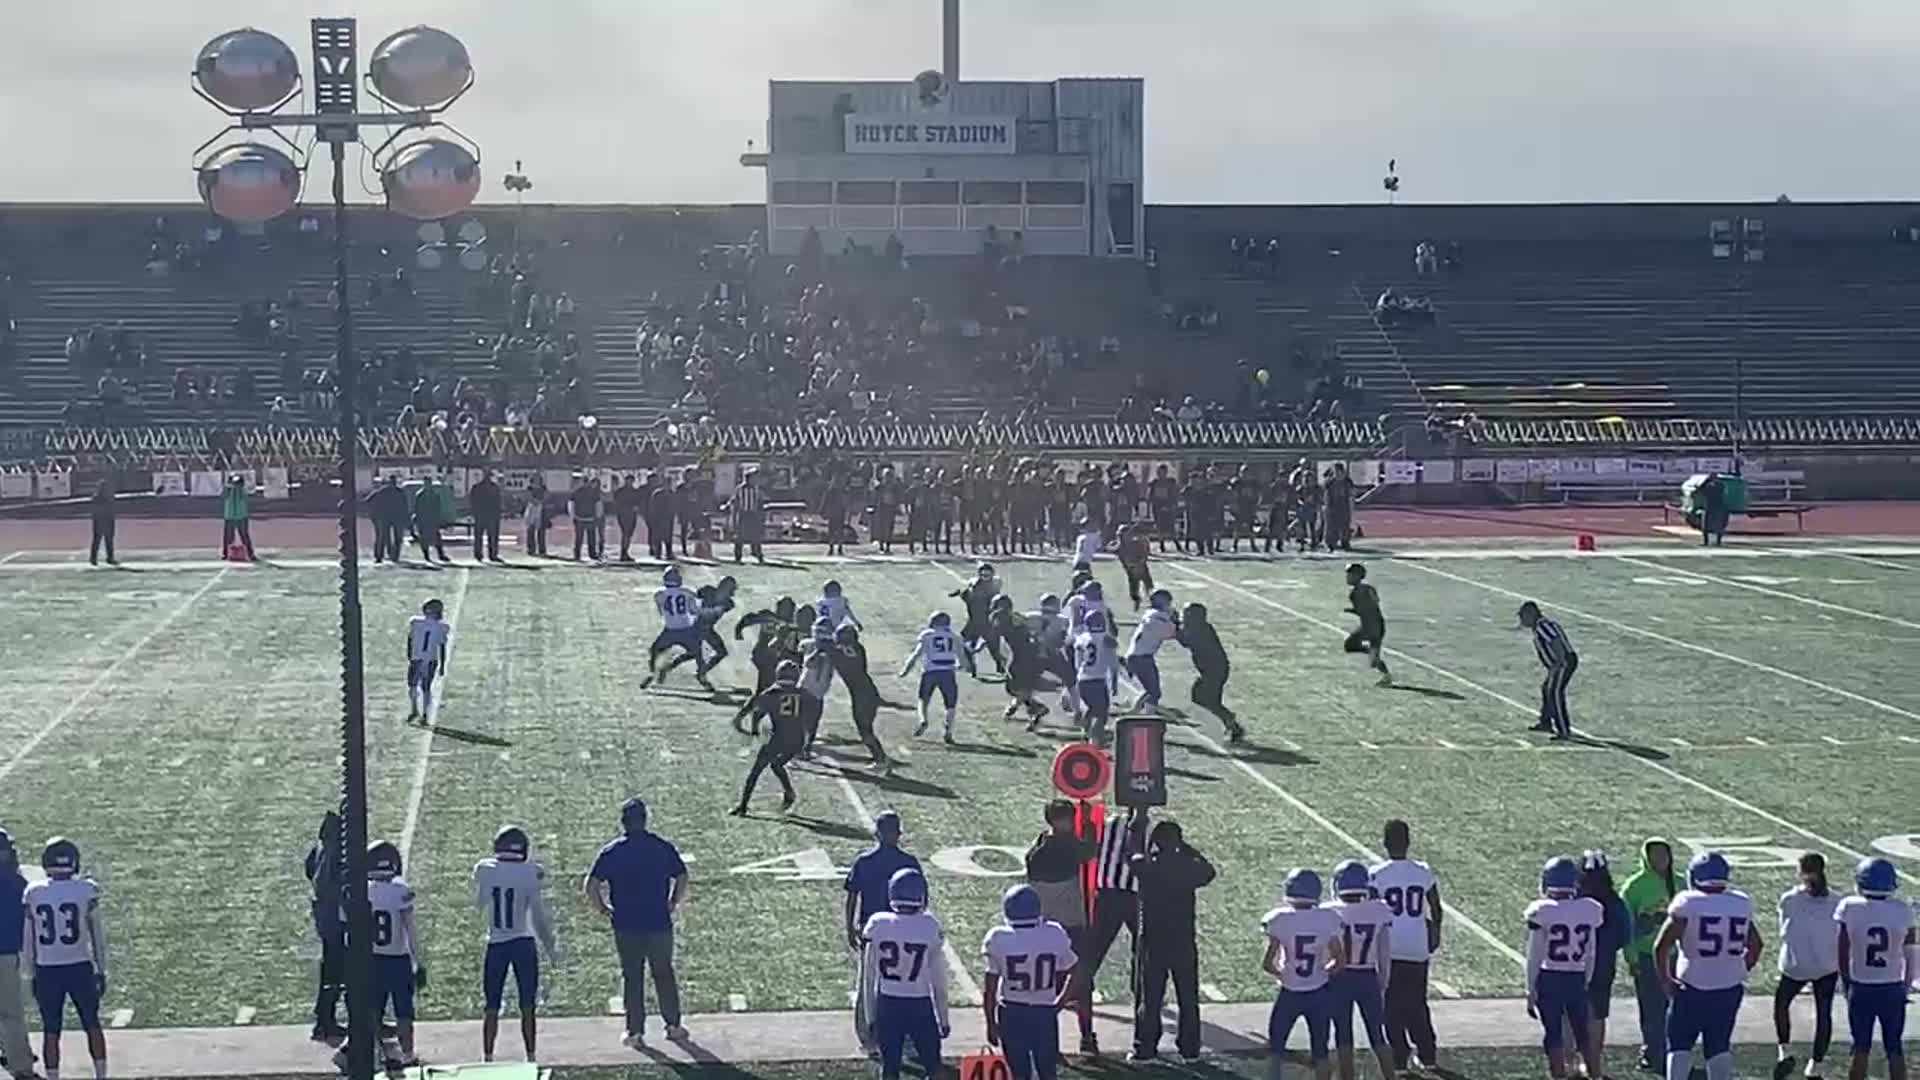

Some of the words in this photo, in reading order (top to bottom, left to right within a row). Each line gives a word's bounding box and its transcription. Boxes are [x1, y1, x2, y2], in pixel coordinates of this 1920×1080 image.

[855, 124, 919, 144] HUYCK
[925, 124, 1007, 144] STADIUM
[663, 594, 687, 617] 48
[421, 630, 431, 650] 1
[780, 695, 801, 718] 21
[36, 902, 81, 946] 33
[490, 886, 516, 930] 11
[1295, 934, 1317, 978] 5
[1547, 923, 1592, 963] 23
[1698, 916, 1747, 958] 55
[1866, 926, 1890, 968] 2
[878, 941, 928, 983] 27
[1006, 953, 1058, 992] 50
